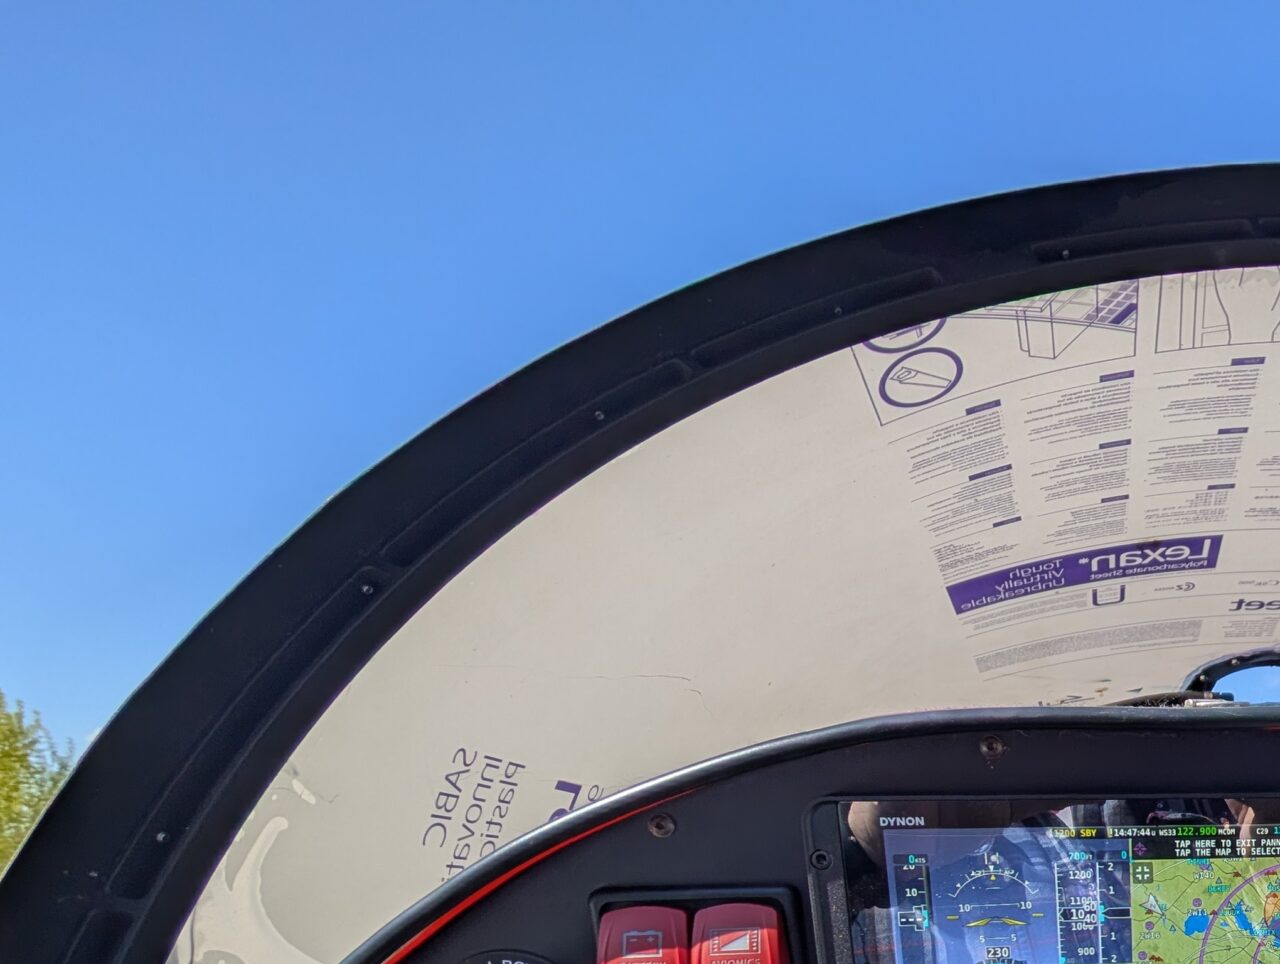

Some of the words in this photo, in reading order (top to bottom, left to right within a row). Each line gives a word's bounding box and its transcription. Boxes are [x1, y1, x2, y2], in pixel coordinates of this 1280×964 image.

[879, 816, 925, 827] DYNON
[1080, 828, 1097, 837] SBY
[1177, 826, 1217, 836] 122.900
[1174, 840, 1191, 848] TAP
[1221, 839, 1232, 847] TO
[1236, 839, 1257, 847] EXIT
[1174, 849, 1191, 857] TAP
[1195, 848, 1211, 856] THE
[1215, 848, 1232, 856] MAP
[1236, 848, 1247, 856] TO
[1251, 847, 1280, 855] SELECT
[1069, 870, 1092, 879] 1200
[905, 888, 918, 897] 10
[959, 904, 970, 912] 10
[1020, 901, 1032, 909] 10
[987, 948, 1009, 957] 230
[1077, 947, 1095, 955] 900
